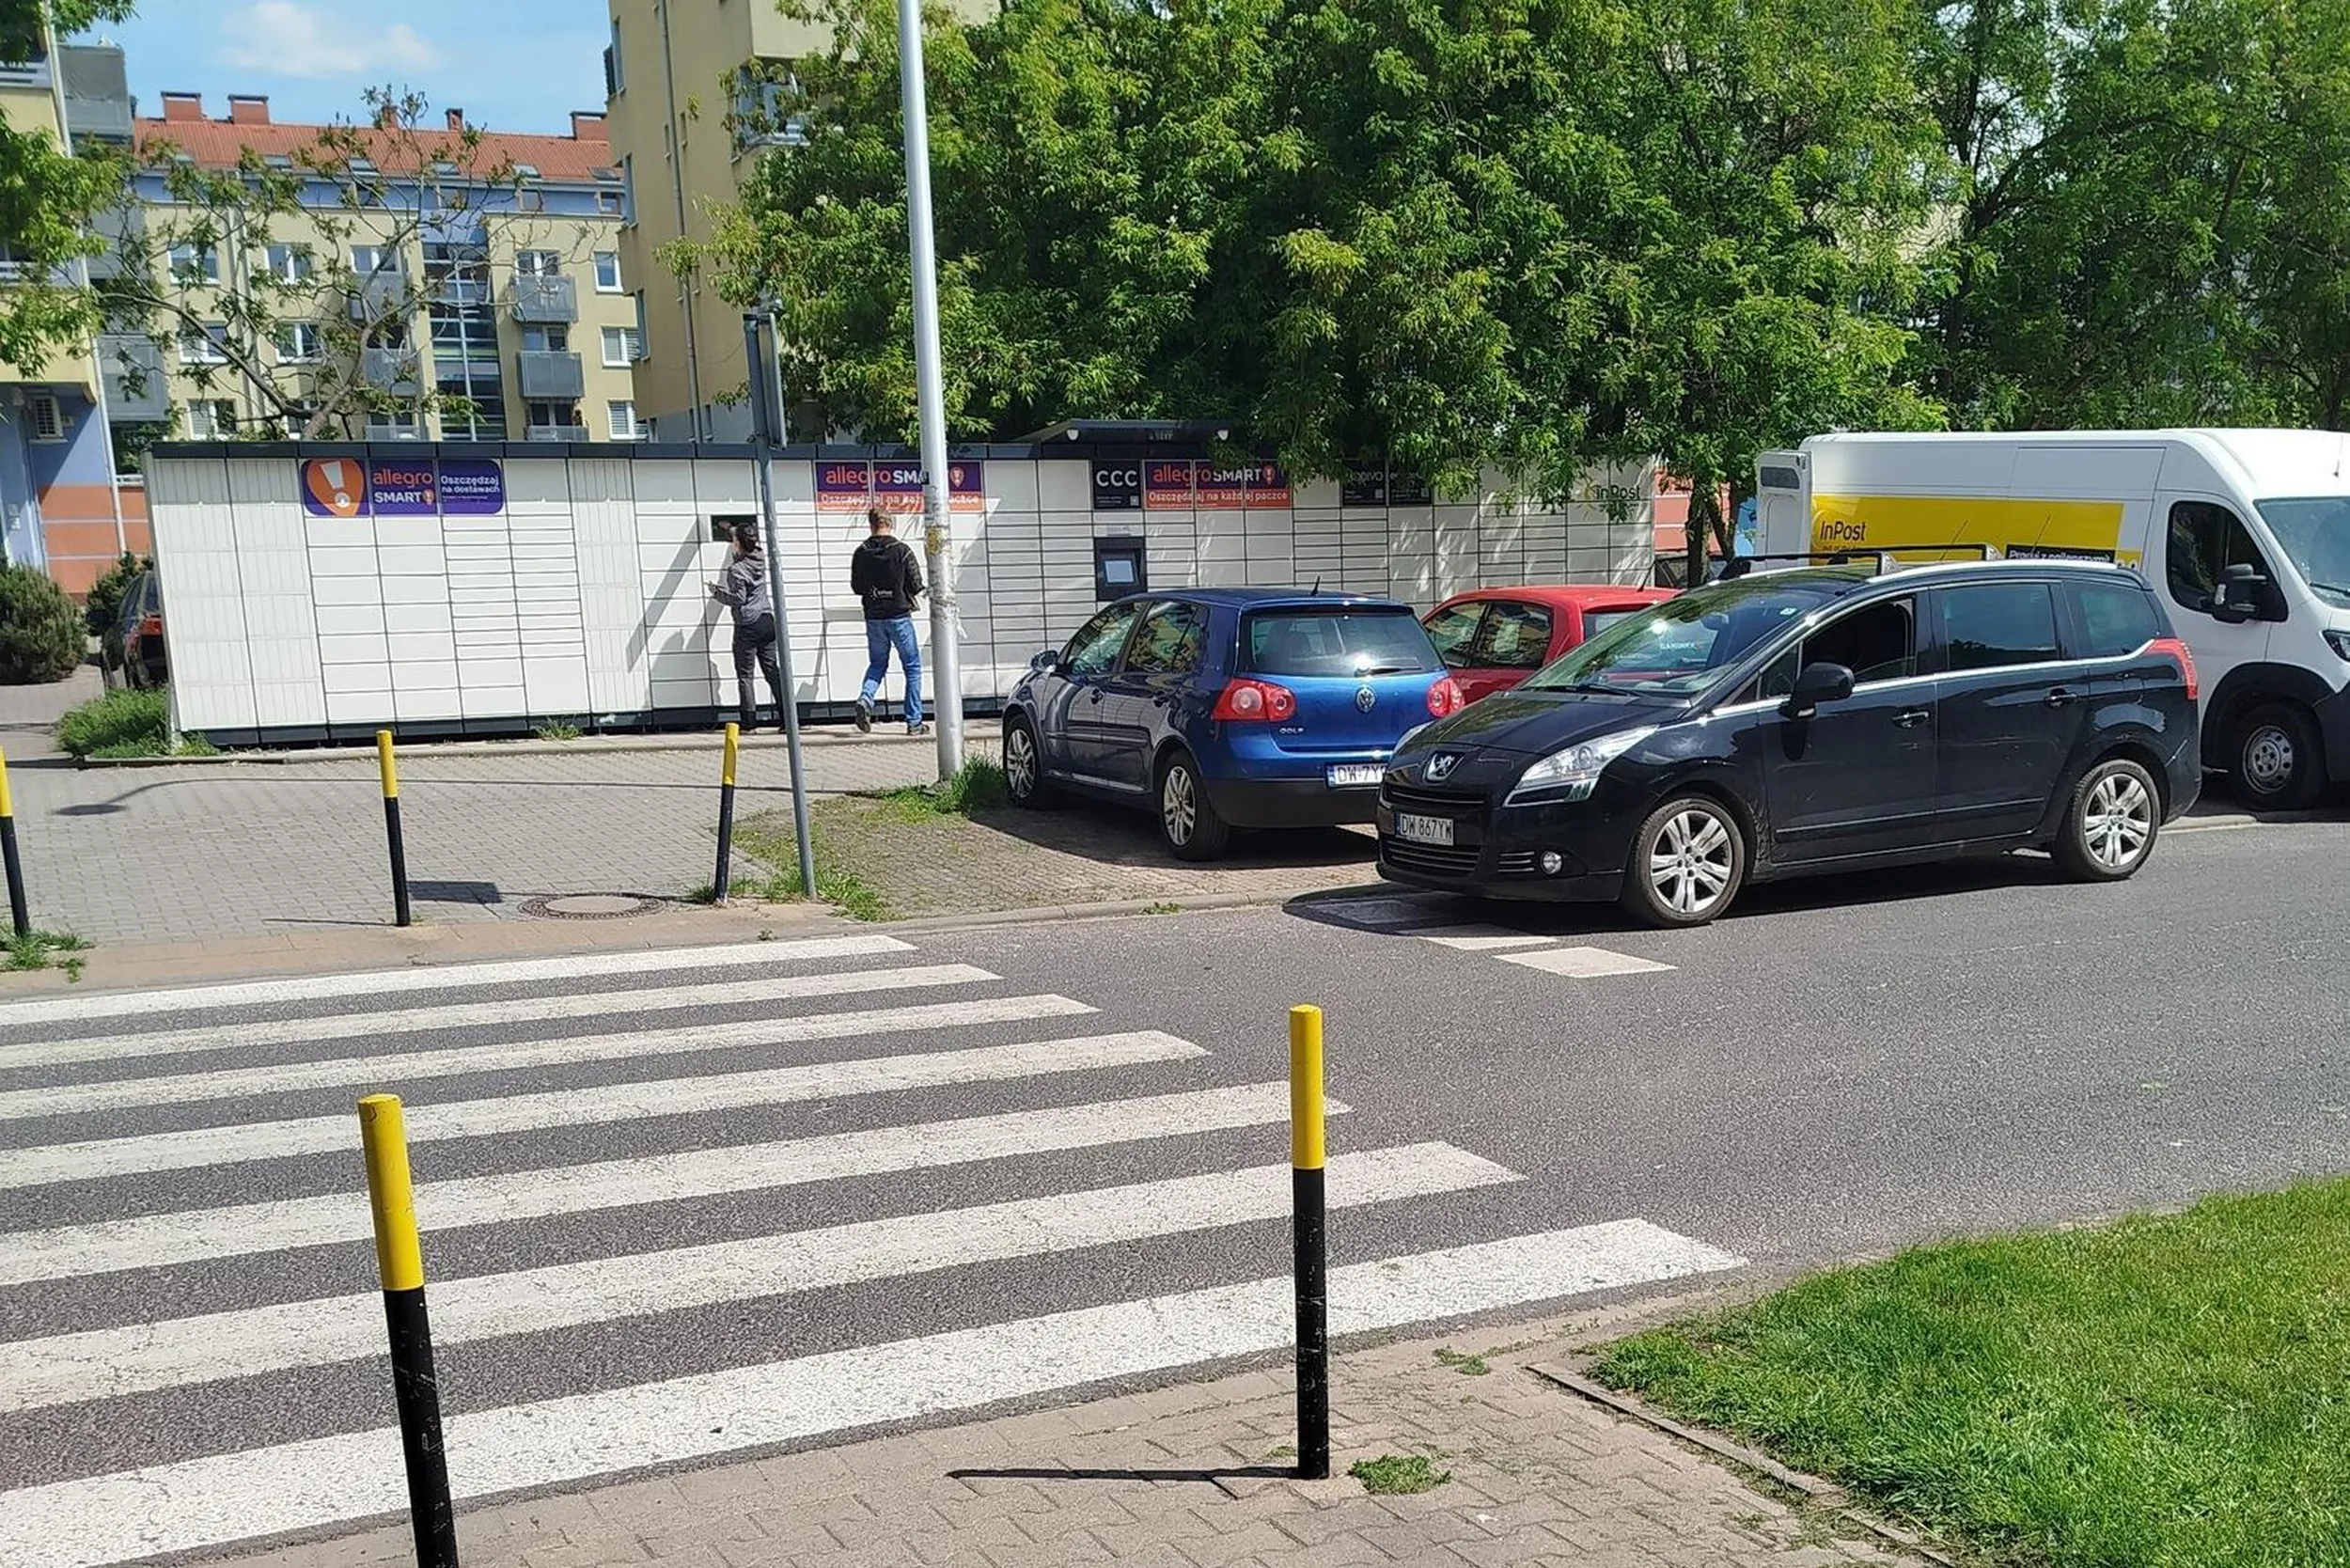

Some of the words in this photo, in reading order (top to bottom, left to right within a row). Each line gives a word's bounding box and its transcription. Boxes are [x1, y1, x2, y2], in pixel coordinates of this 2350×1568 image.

[372, 469, 433, 489] allegro
[440, 475, 500, 486] Oszczędzaj
[825, 466, 891, 488] allegro
[1096, 470, 1137, 487] CCC
[1152, 464, 1212, 487] allegro
[1213, 469, 1261, 482] SMART
[374, 492, 422, 504] SMART
[1820, 521, 1866, 541] InPost
[1337, 766, 1358, 783] DW
[1401, 814, 1416, 834] DW
[1418, 817, 1452, 839] 867YW
